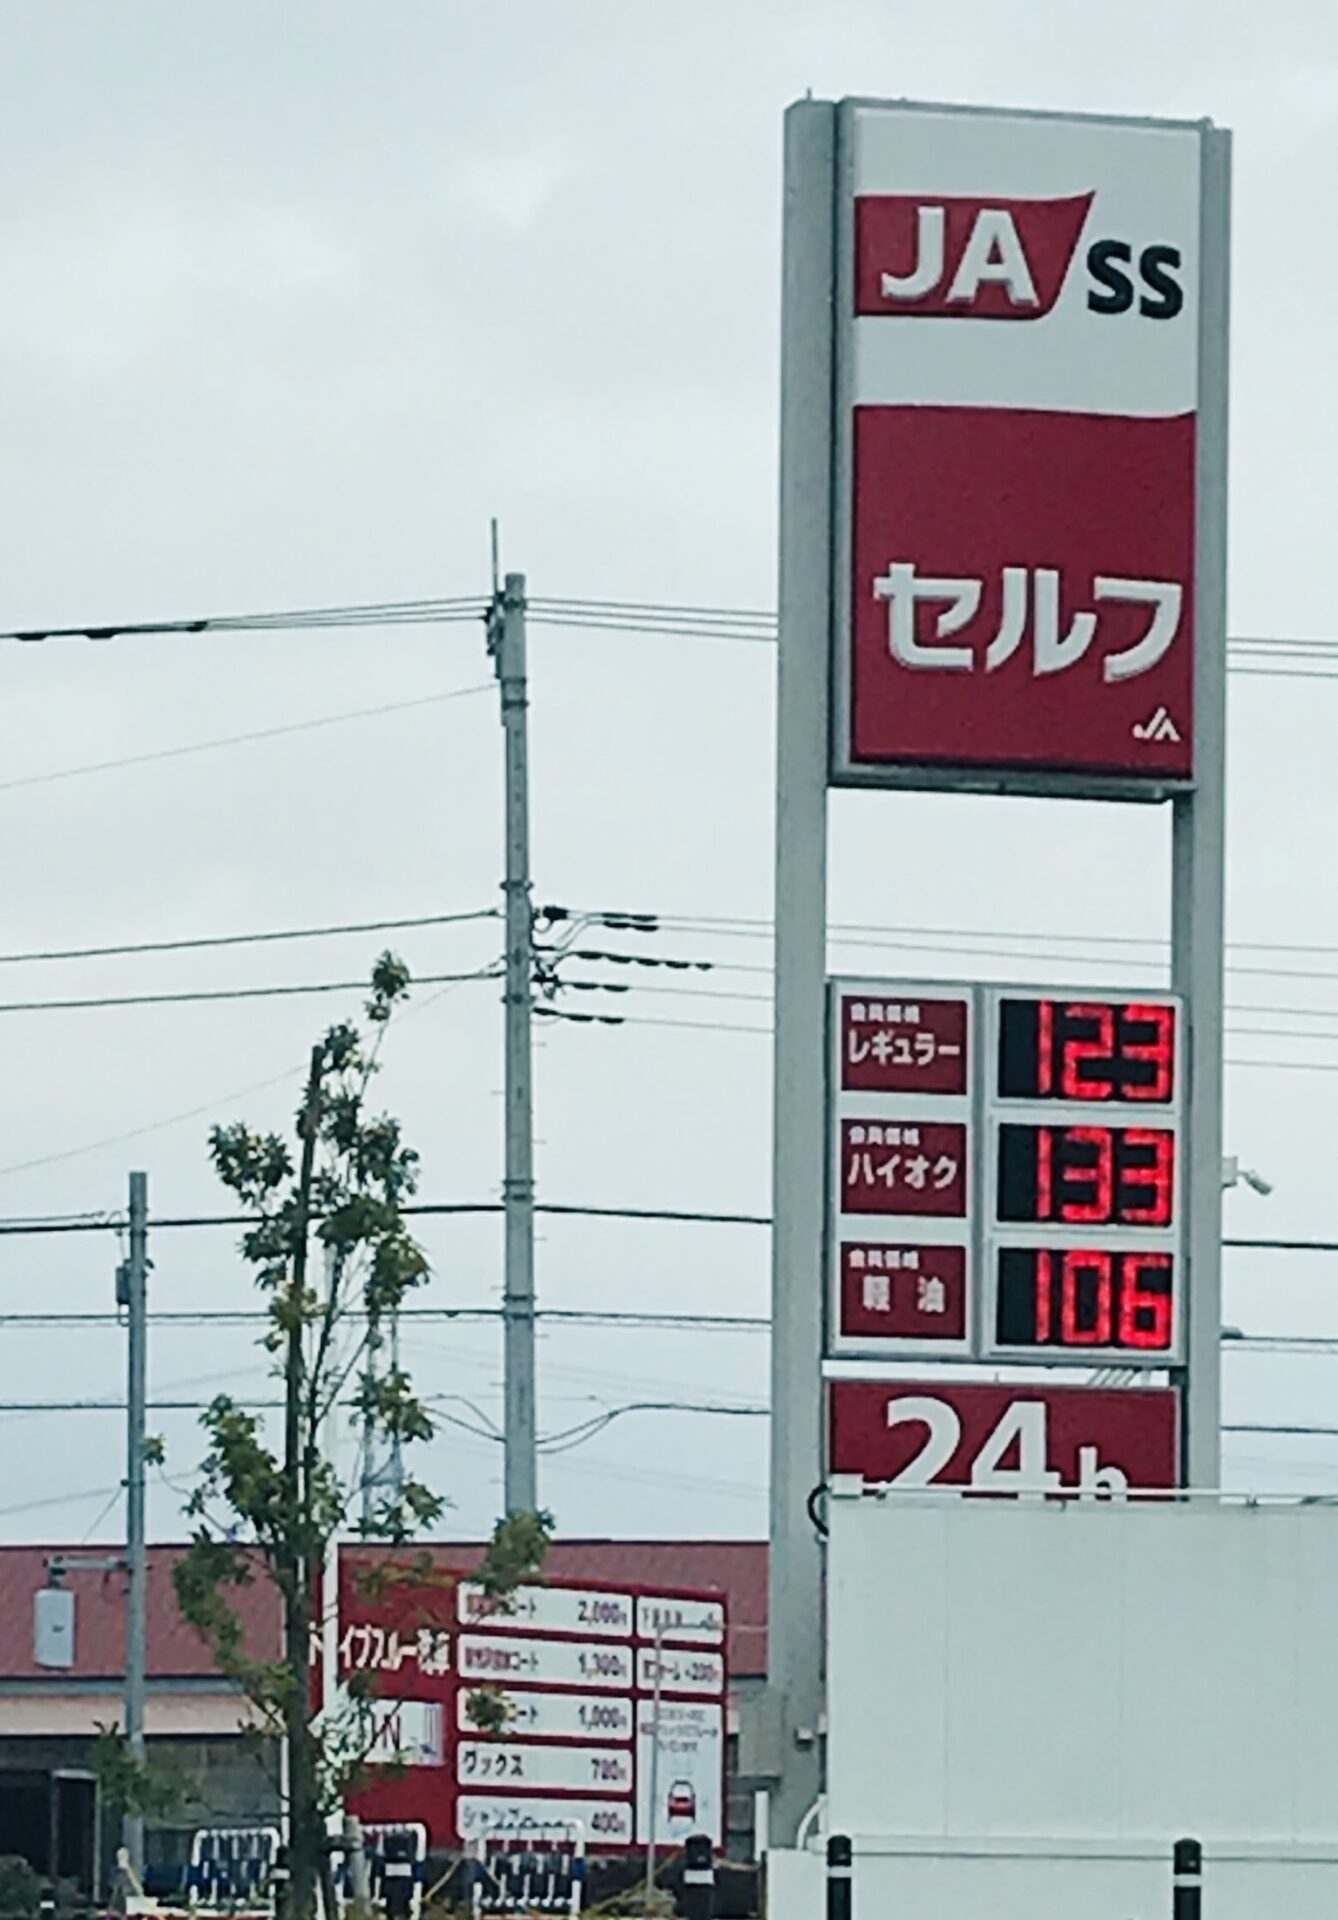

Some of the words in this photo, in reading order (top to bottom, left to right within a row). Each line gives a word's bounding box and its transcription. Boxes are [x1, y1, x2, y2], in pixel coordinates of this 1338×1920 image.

[881, 206, 1040, 308] JA
[1086, 238, 1185, 320] SS
[873, 562, 1184, 684] セルフ
[848, 1029, 960, 1066] レギュラー
[1037, 1000, 1174, 1099] 123
[848, 1153, 958, 1190] ハイオク
[1036, 1126, 1174, 1226] 133
[1035, 1248, 1173, 1349] 106
[887, 1396, 1128, 1501] 24h
